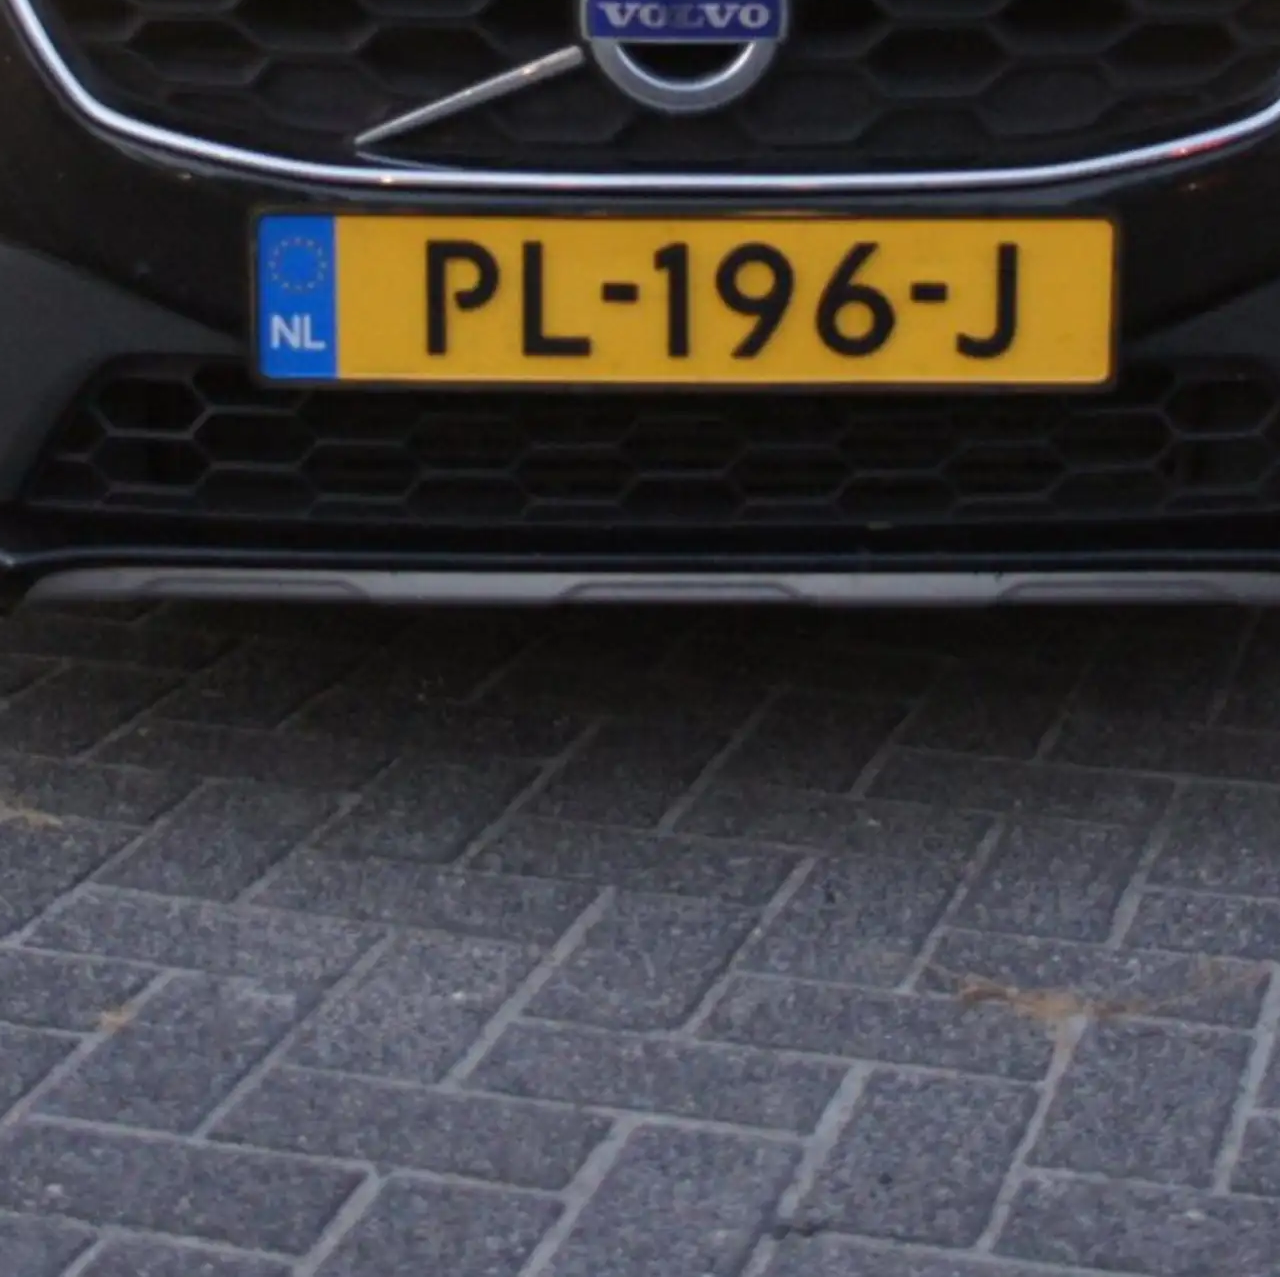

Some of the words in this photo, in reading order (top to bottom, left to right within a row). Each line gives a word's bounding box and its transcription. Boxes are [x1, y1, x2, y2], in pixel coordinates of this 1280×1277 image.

[597, 2, 770, 29] VOLVO
[424, 239, 1019, 362] PL-196-J
[270, 314, 326, 350] NL
